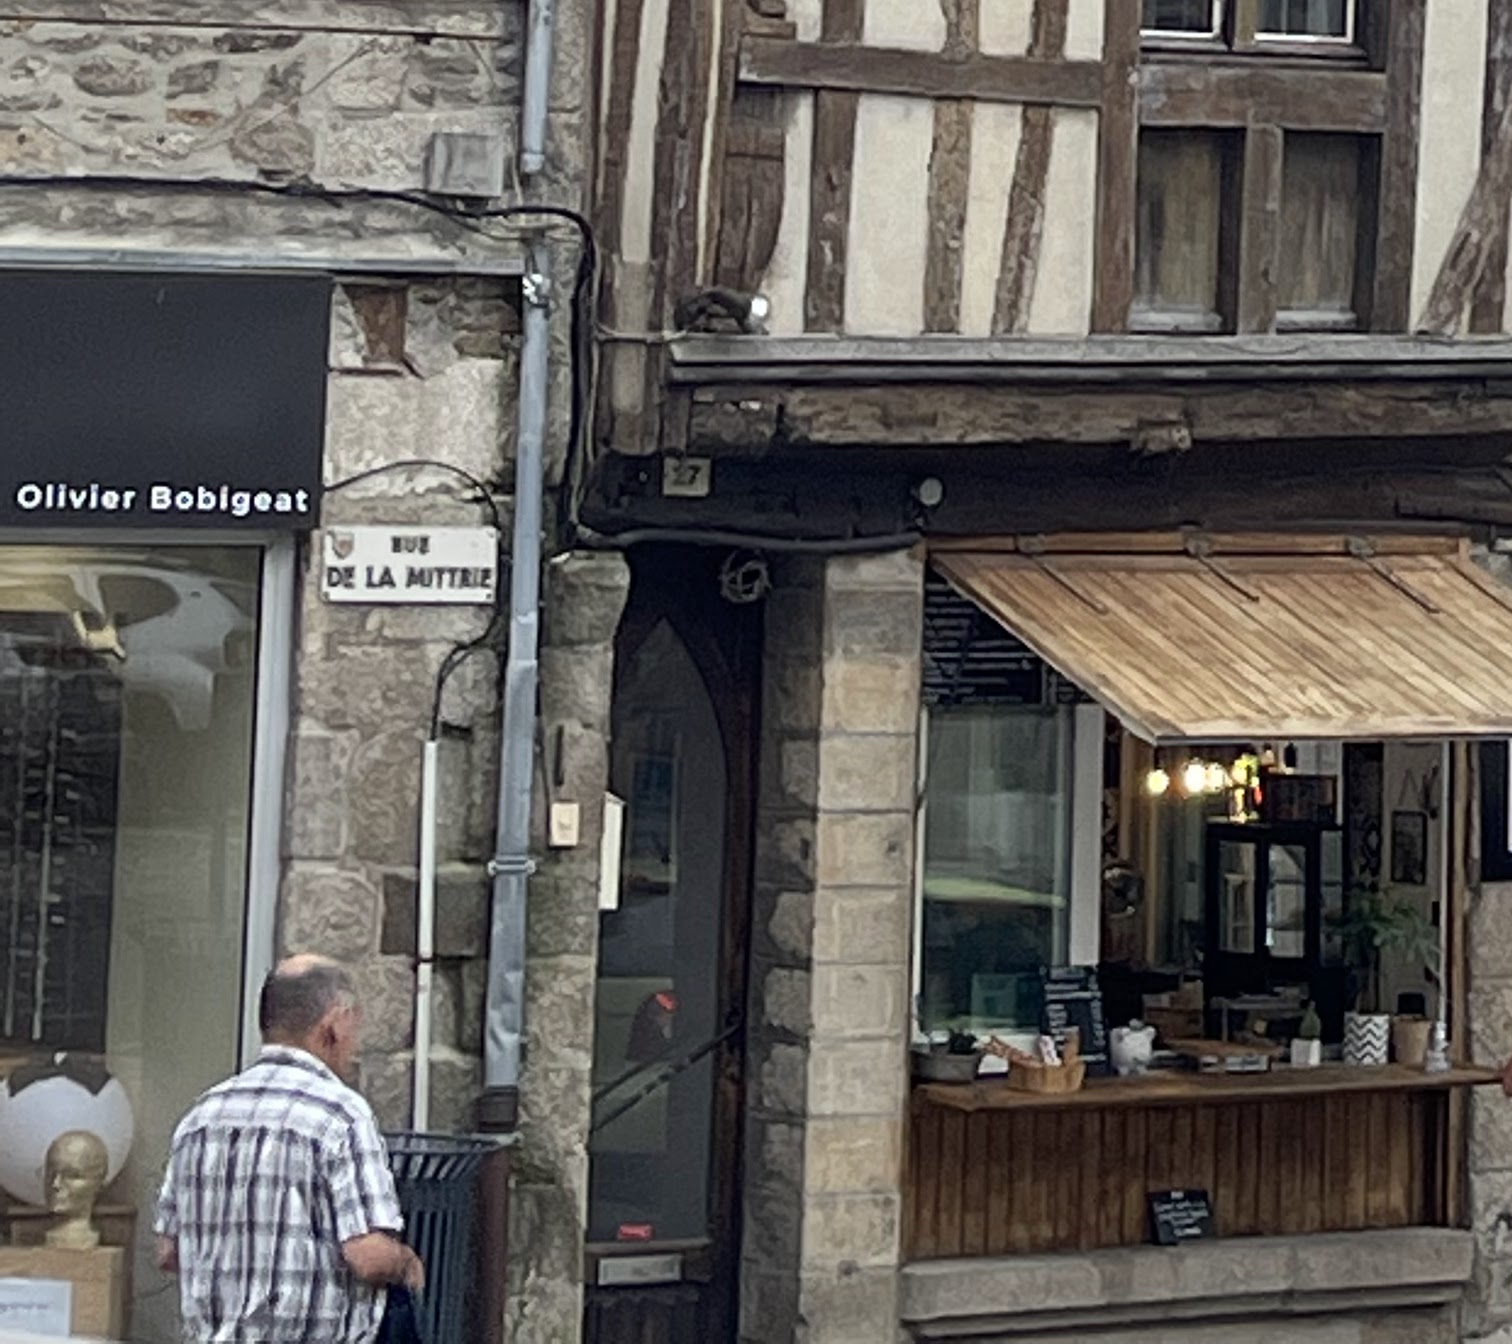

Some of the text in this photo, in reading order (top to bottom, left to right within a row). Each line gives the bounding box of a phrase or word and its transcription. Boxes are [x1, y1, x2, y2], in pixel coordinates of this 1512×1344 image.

[17, 483, 309, 517] Olivier Bobigeat
[391, 535, 431, 555] RUE
[327, 565, 355, 589] DE
[366, 564, 396, 589] LA
